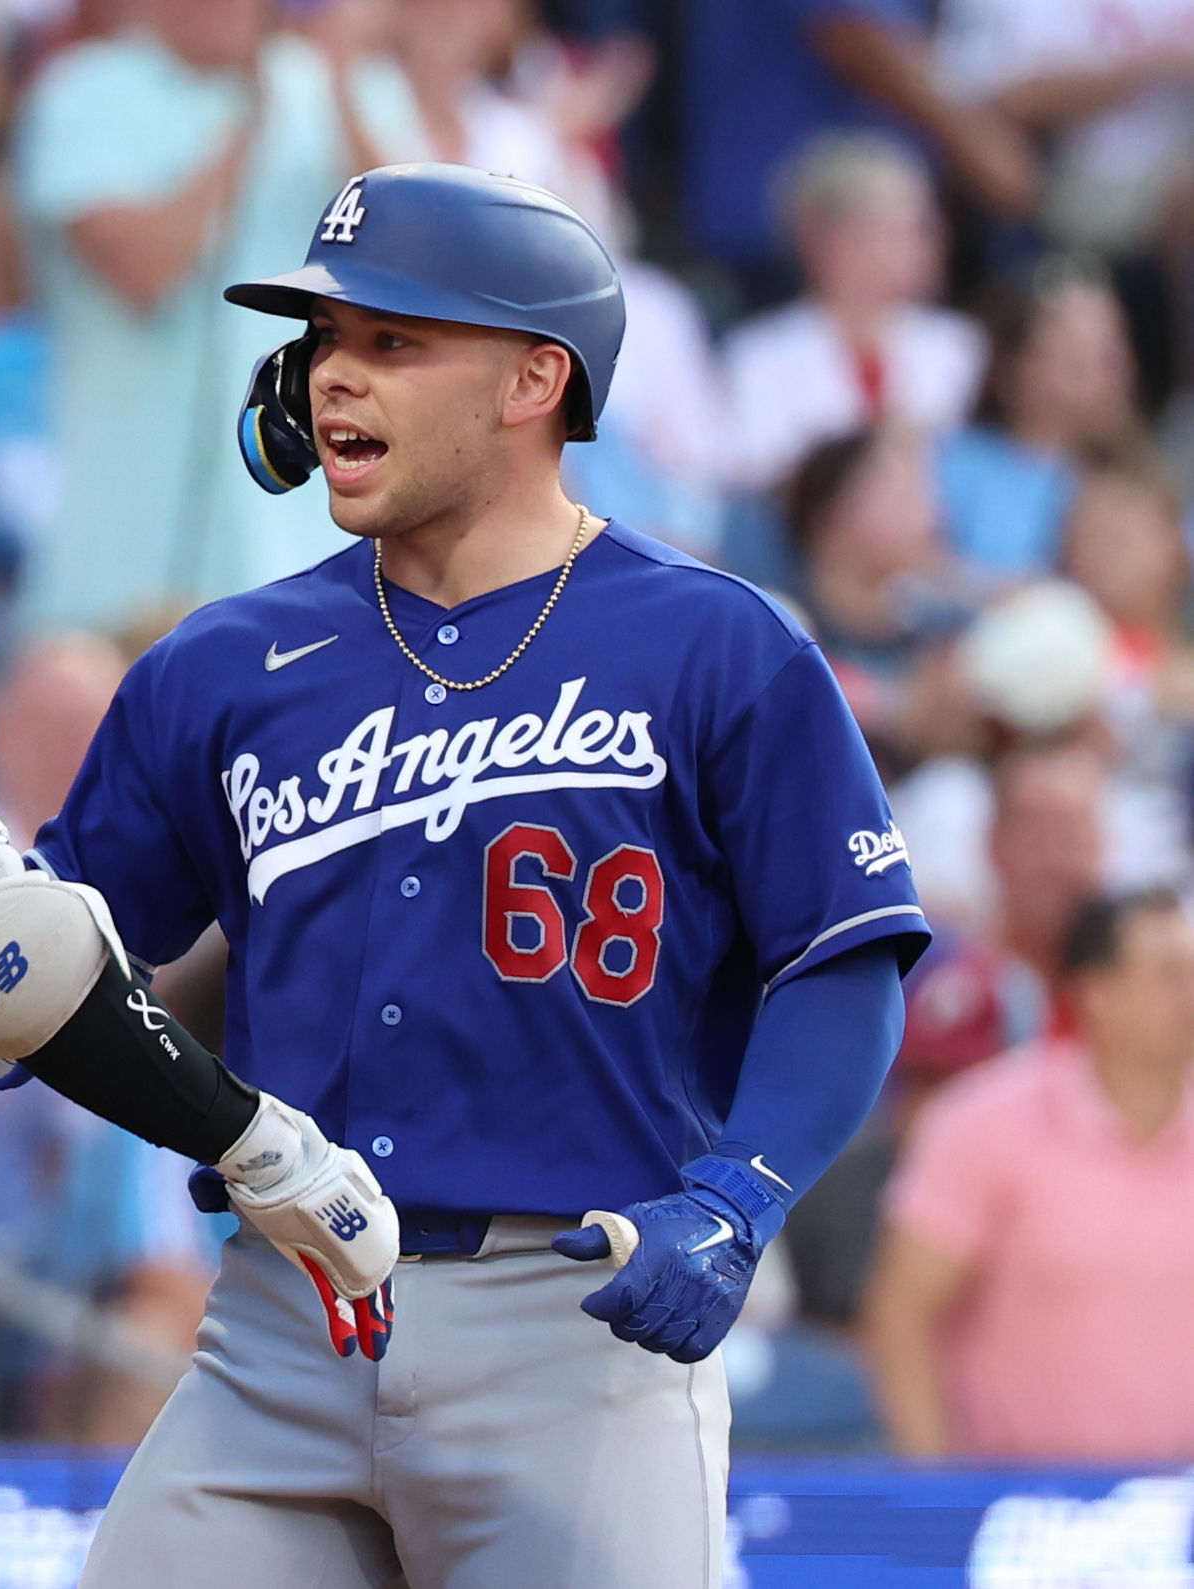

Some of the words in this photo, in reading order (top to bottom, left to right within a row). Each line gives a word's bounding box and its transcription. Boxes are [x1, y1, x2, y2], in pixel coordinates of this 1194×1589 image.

[220, 752, 306, 865] Los
[306, 676, 667, 843] Angeles
[481, 820, 665, 1008] 68
